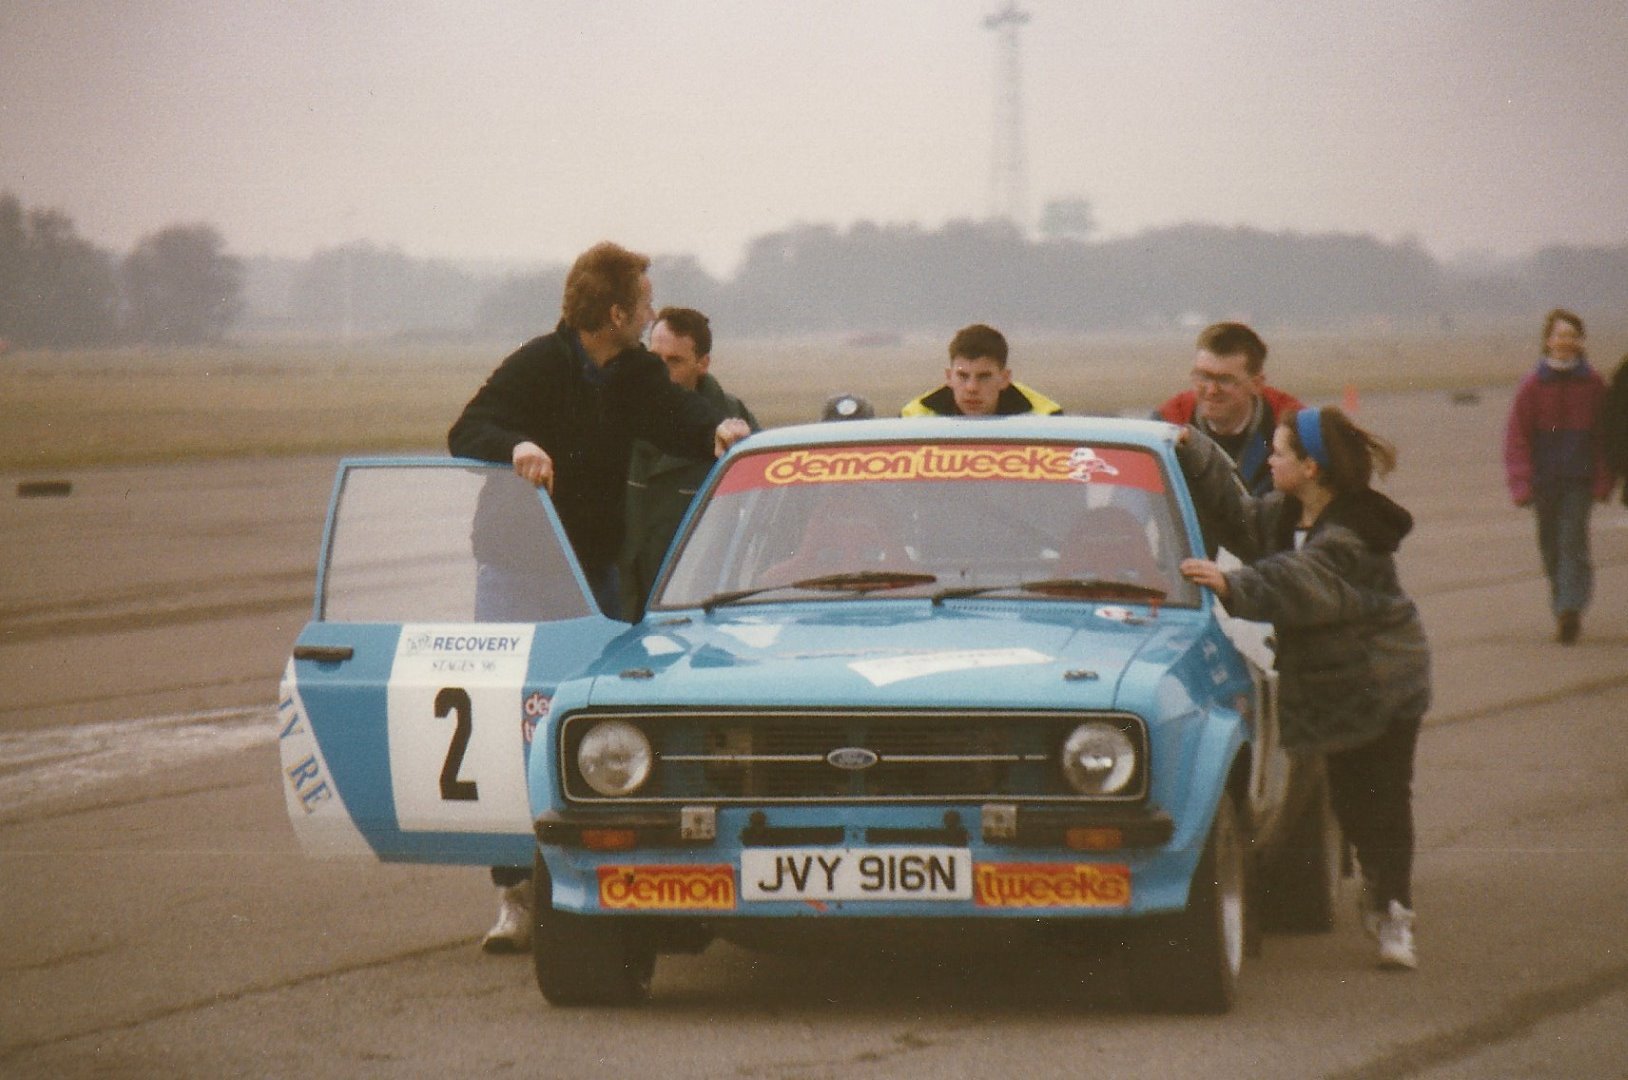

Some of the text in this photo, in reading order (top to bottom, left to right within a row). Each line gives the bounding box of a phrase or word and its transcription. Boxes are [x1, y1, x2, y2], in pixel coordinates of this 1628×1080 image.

[767, 448, 1075, 483] demon tweeks
[433, 636, 520, 651] RECOVERY
[434, 687, 479, 801] 2
[604, 867, 732, 907] demon
[757, 854, 957, 893] JVY 916N
[980, 866, 1124, 905] tweeks
